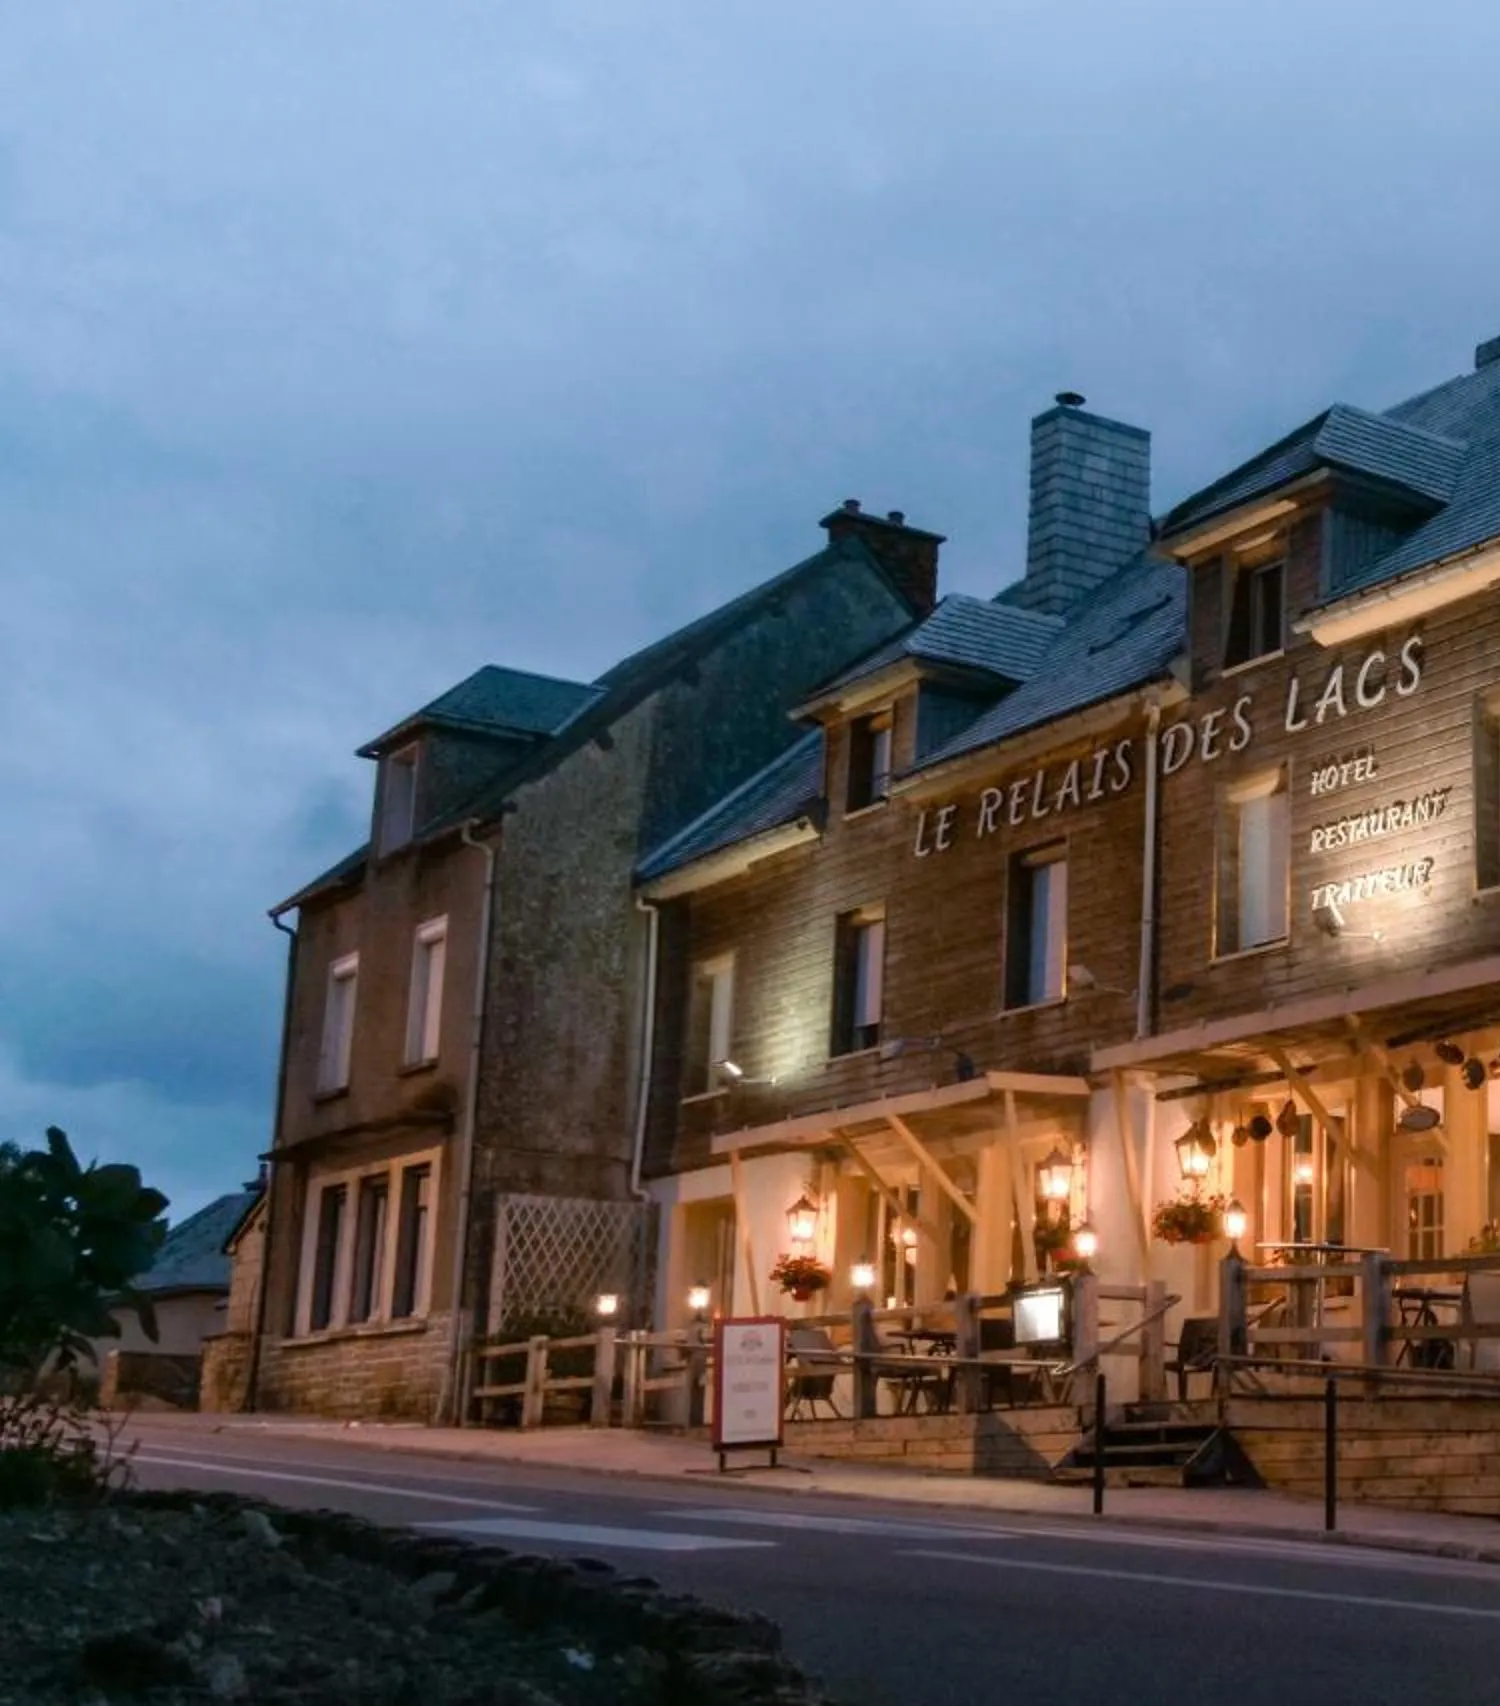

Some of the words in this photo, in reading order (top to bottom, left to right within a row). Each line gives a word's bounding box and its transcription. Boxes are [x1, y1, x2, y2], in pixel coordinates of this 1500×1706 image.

[913, 803, 957, 858] LE
[976, 739, 1132, 839] RELAIS
[1161, 695, 1251, 775] DES
[1285, 636, 1422, 732] LACS
[1310, 755, 1377, 795] HOTEL
[1310, 792, 1448, 853] RESTAURANT
[1311, 861, 1431, 911] TRAITEUR
